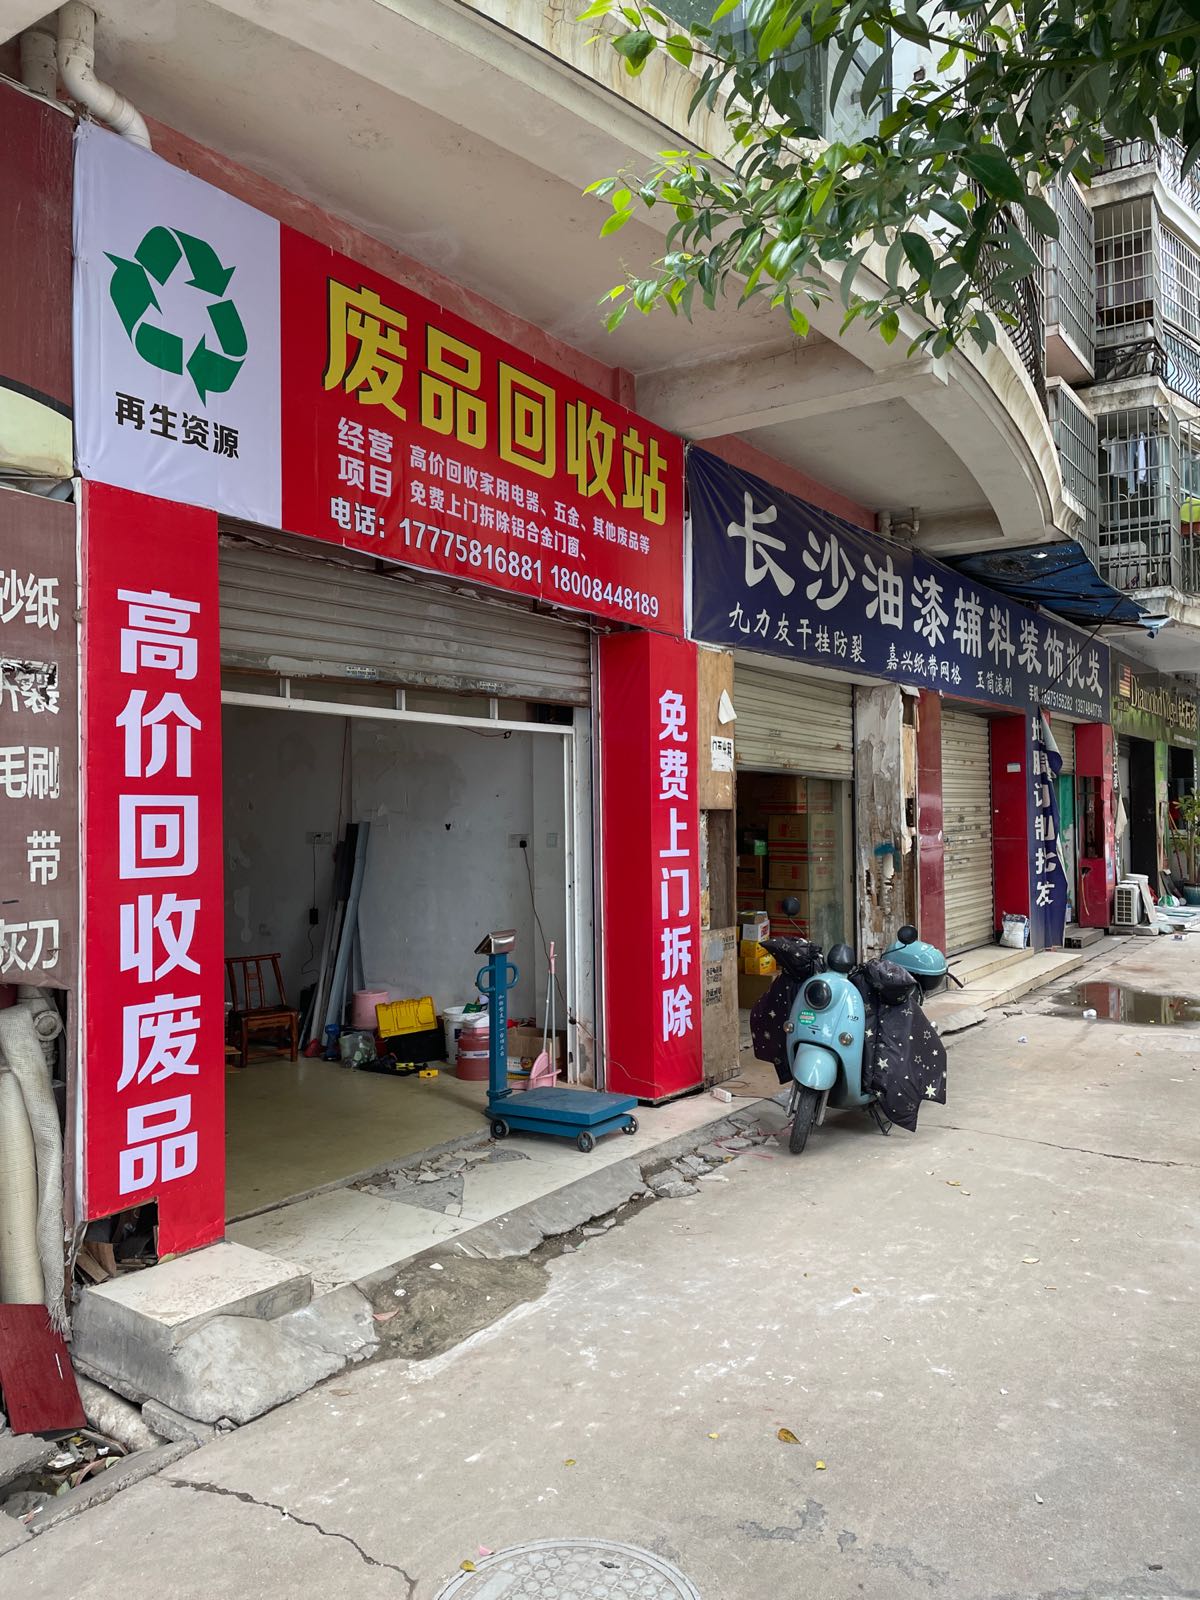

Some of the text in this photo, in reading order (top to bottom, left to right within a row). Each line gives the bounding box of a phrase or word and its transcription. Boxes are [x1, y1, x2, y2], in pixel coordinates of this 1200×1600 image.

[115, 391, 239, 459] 再生资源
[324, 277, 667, 526] 废品回收站
[338, 416, 393, 463] 经营
[338, 454, 392, 497] 项目
[399, 517, 542, 584] 17775816881
[550, 564, 659, 618] 18008448189
[727, 491, 1103, 698] 长沙油漆辅料装饰批发
[0, 746, 60, 800] 毛刷
[116, 588, 201, 1196] 高价回收废品
[658, 689, 693, 1042] 免费上门拆除
[0, 918, 60, 974] 灰刀
